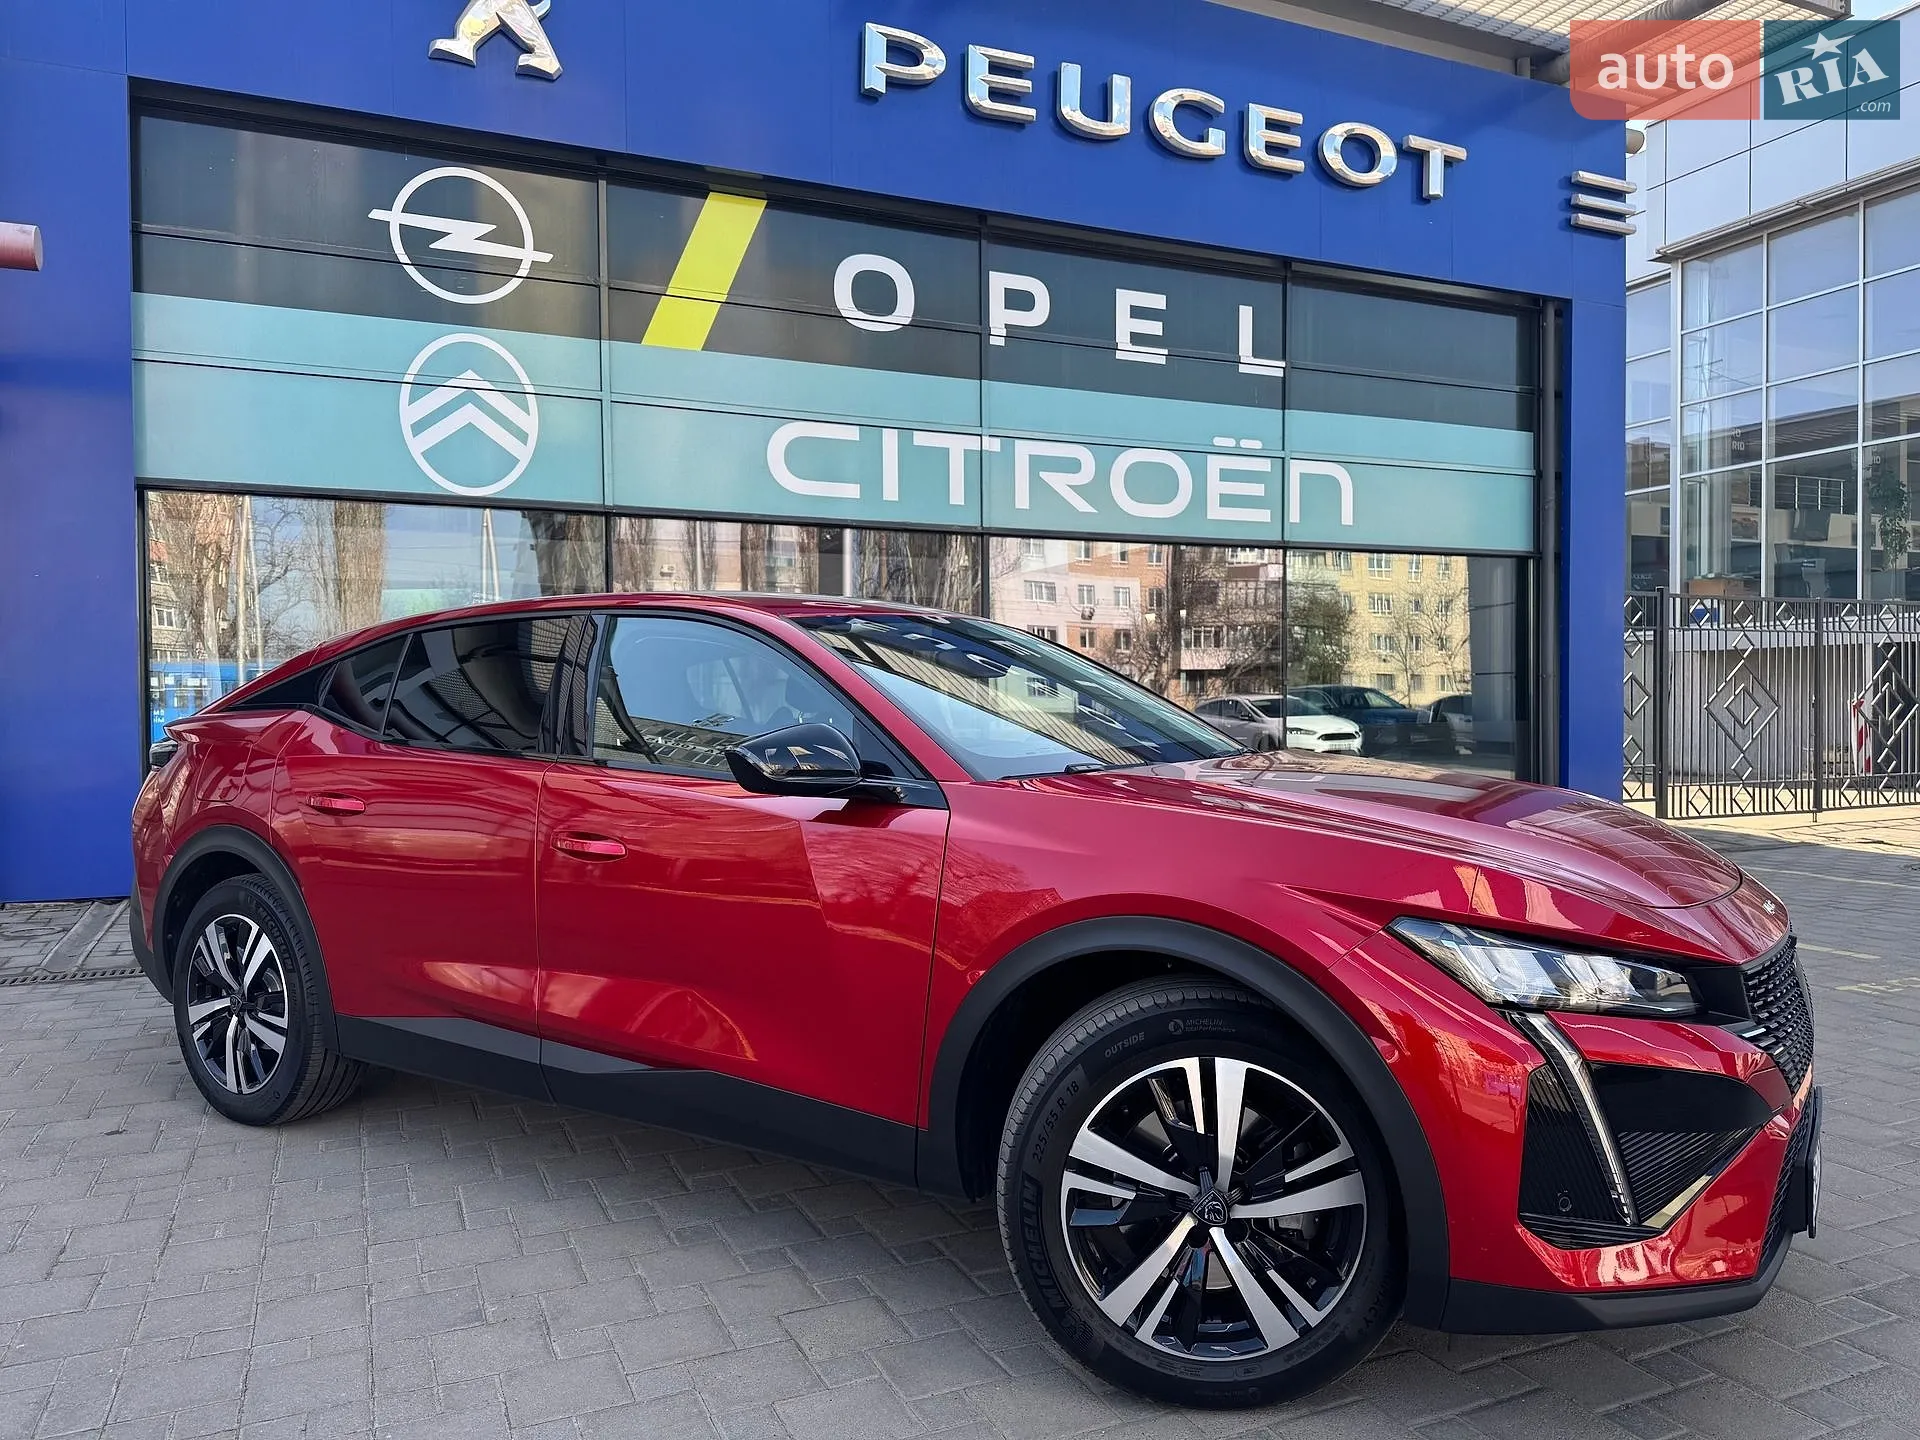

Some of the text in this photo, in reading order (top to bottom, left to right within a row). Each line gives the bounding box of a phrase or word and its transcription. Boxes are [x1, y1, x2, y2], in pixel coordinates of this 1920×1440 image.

[862, 22, 1467, 201] PEUGEOT
[833, 253, 1286, 378] OPEL
[1104, 1031, 1145, 1059] OUTSIDE
[1185, 1016, 1224, 1026] MICHELIN
[1058, 1097, 1068, 1112] R
[1066, 1080, 1081, 1098] 18
[1023, 1178, 1068, 1308] MICHELIN
